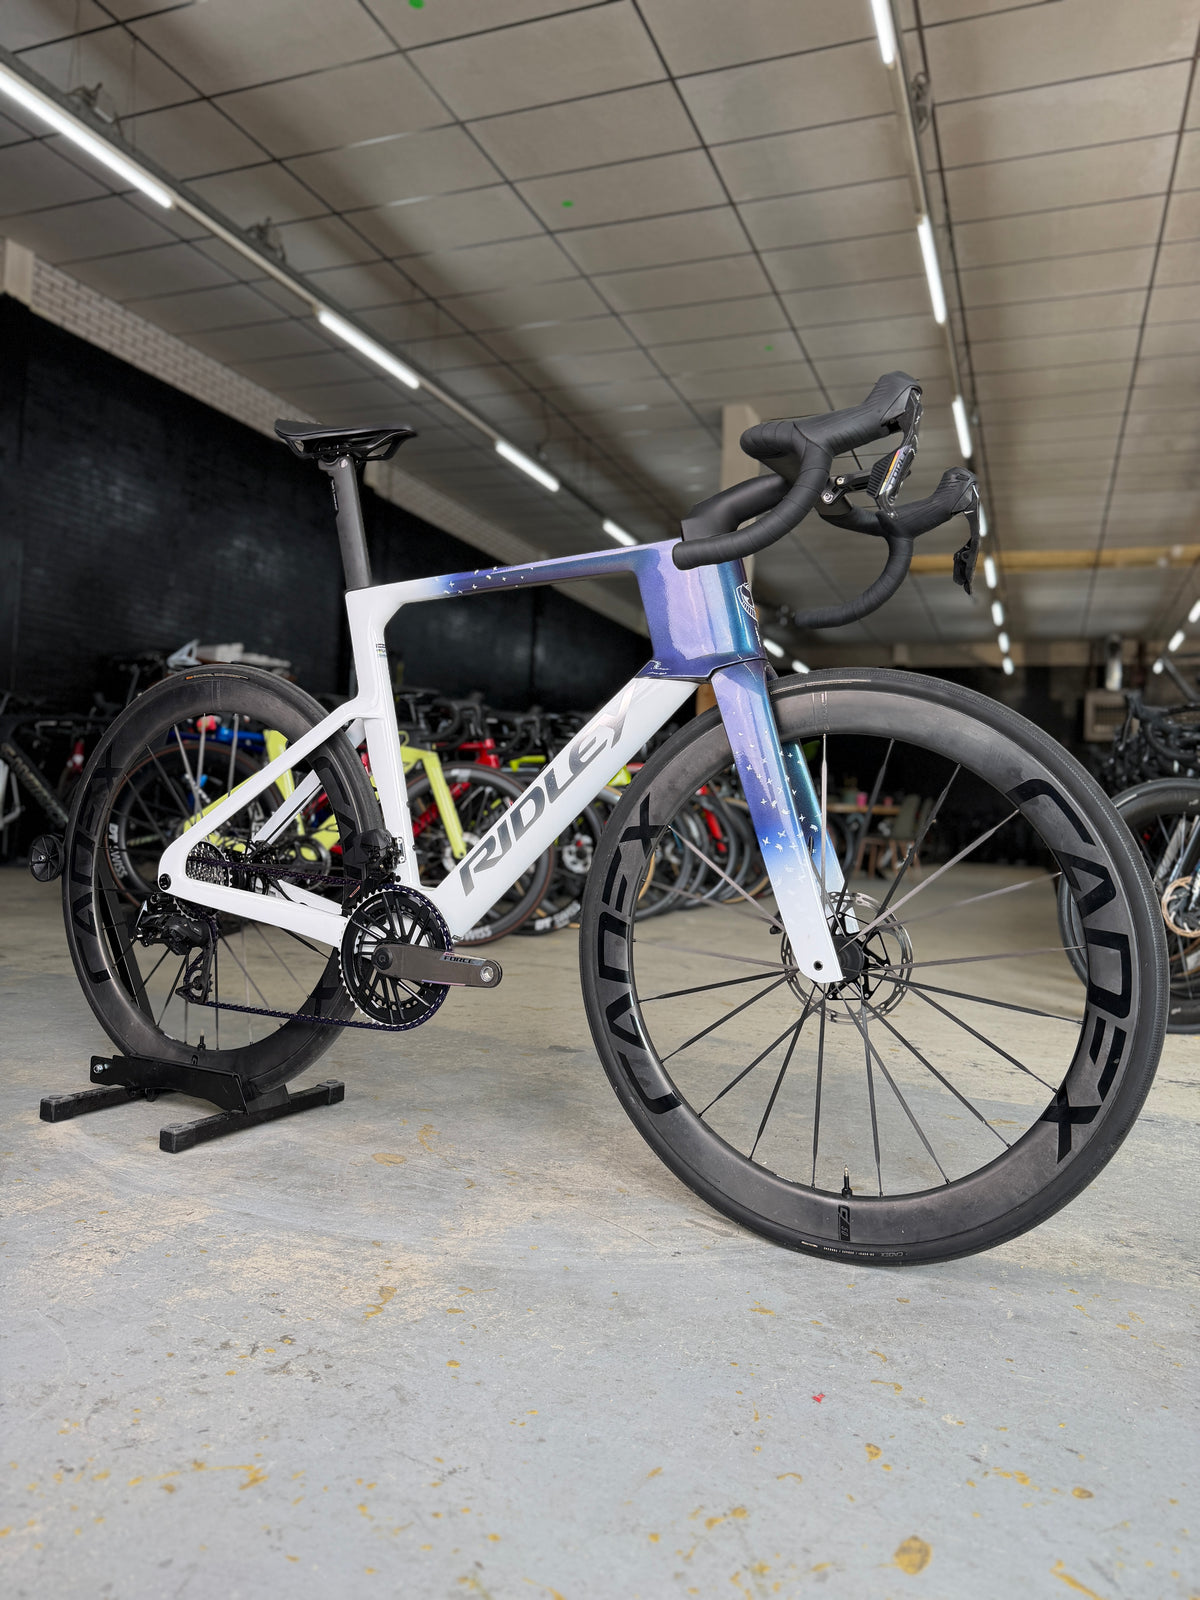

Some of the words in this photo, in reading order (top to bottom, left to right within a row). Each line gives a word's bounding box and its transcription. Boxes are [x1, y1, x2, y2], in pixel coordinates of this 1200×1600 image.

[108, 822, 119, 843] DT
[459, 685, 638, 897] RIDLEY
[463, 924, 493, 941] WISS
[599, 792, 682, 1114] CADEX
[1006, 779, 1132, 1164] CADEX
